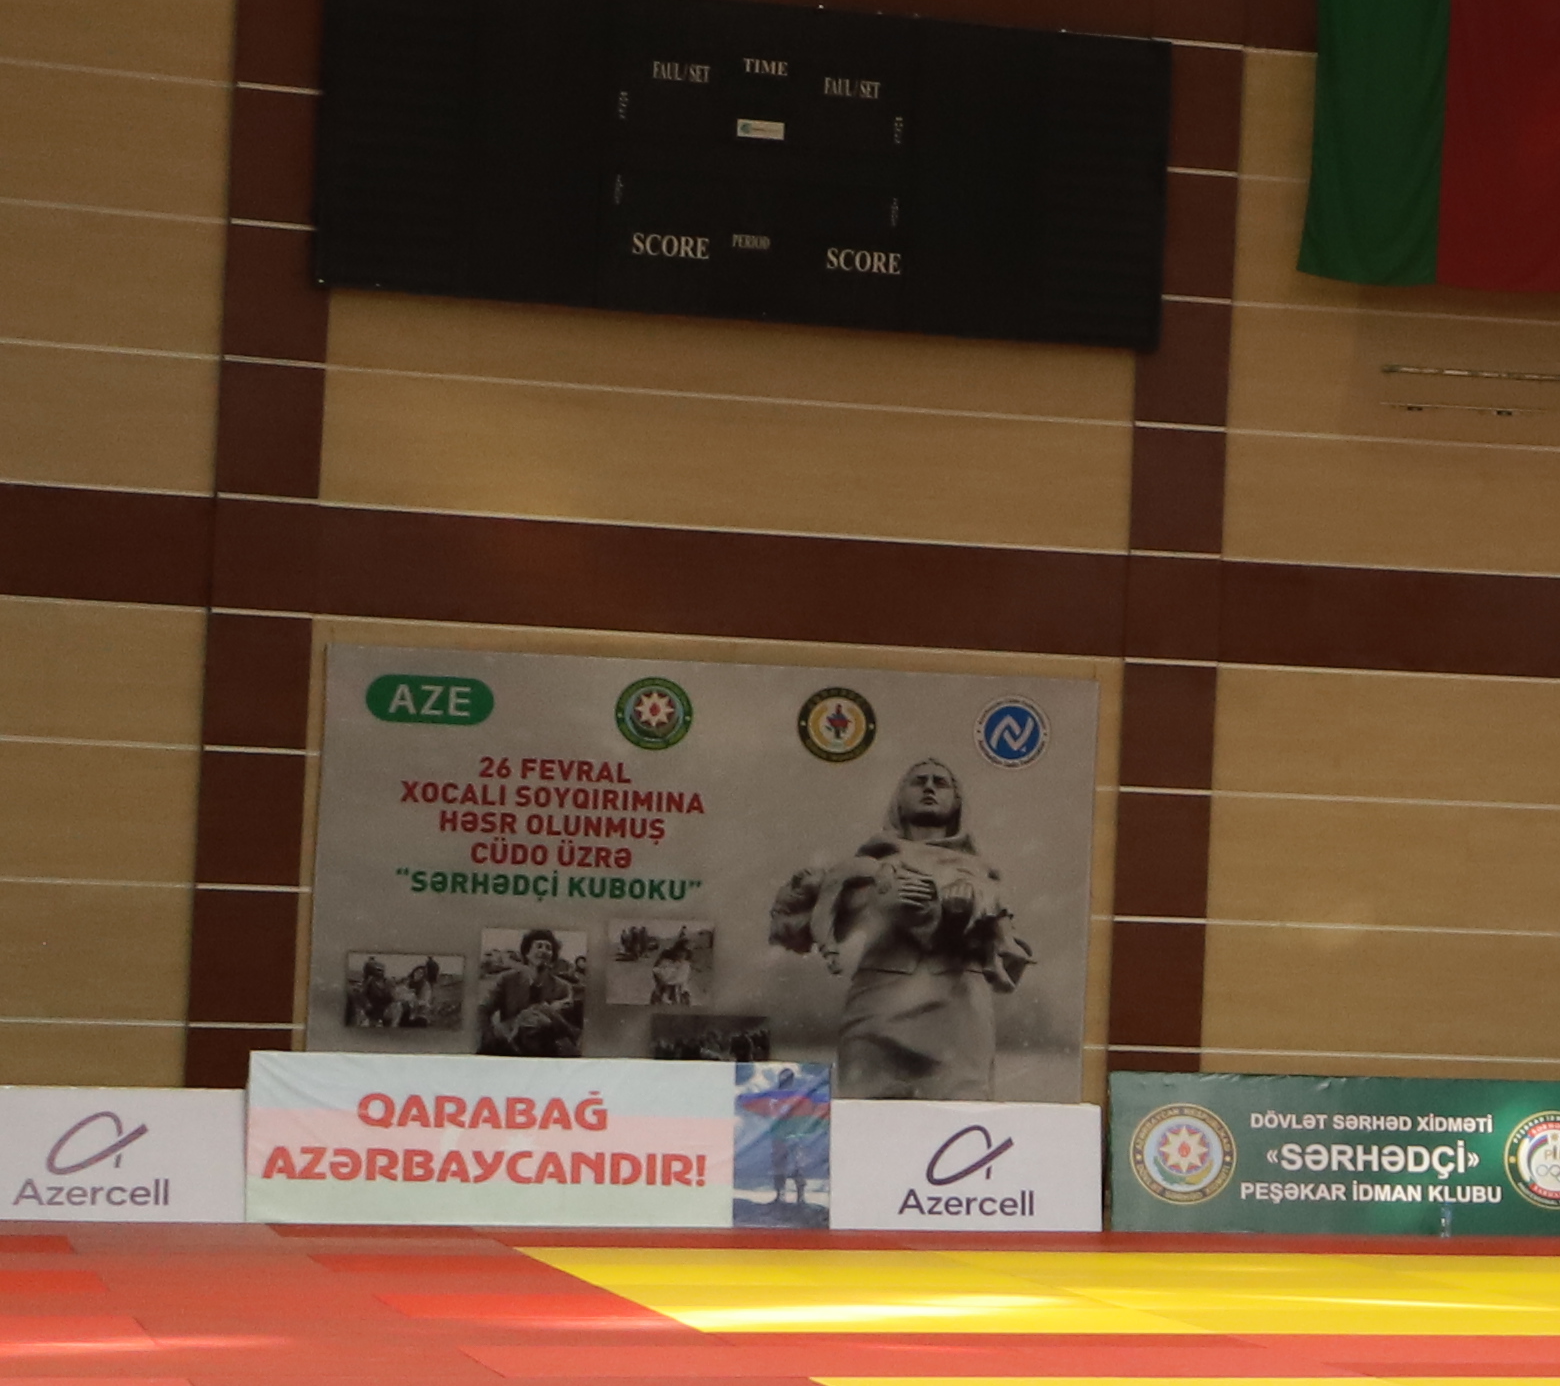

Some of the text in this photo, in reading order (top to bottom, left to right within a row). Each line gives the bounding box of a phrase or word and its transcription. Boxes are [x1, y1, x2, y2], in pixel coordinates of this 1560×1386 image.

[743, 57, 788, 76] TIME
[632, 232, 710, 260] SCORE
[826, 247, 901, 274] SCORE
[389, 683, 472, 717] AZE
[479, 756, 632, 784] 26 FEVRAL
[400, 780, 705, 814] XOCALI SOYQIRIMINA
[439, 811, 665, 845] HƏSR OLUNMUŞ
[471, 838, 633, 869] CÜDO ÜZRƏ
[357, 1090, 608, 1132] QARABAĞ
[1250, 1111, 1494, 1134] DÖVLƏT SƏRHƏD XİDMƏTİ
[13, 1177, 170, 1207] Azercell
[899, 1188, 1035, 1217] Azercell
[1240, 1180, 1502, 1205] PEŞƏKAR İDMAN KLUBU
